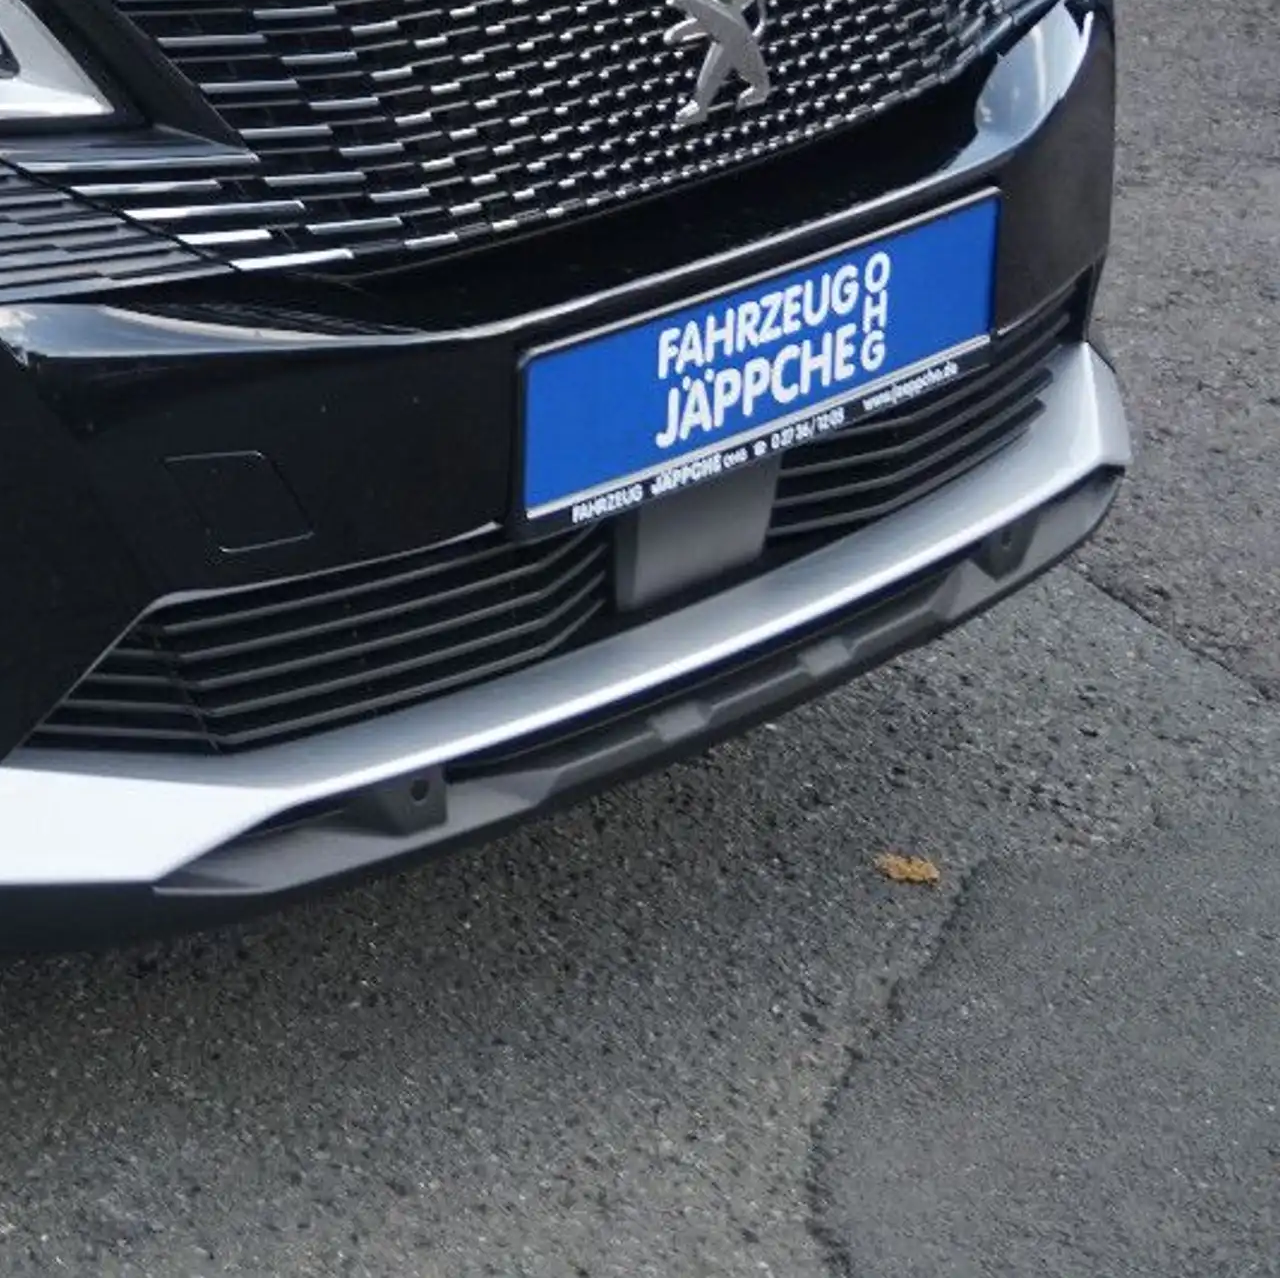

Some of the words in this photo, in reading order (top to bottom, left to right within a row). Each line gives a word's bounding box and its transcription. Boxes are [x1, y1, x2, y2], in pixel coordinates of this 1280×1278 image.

[657, 264, 860, 380] FAHRZEUG
[860, 250, 891, 372] OHG
[655, 322, 858, 449] JÄPPCHE
[571, 482, 644, 523] FAHRZEUG
